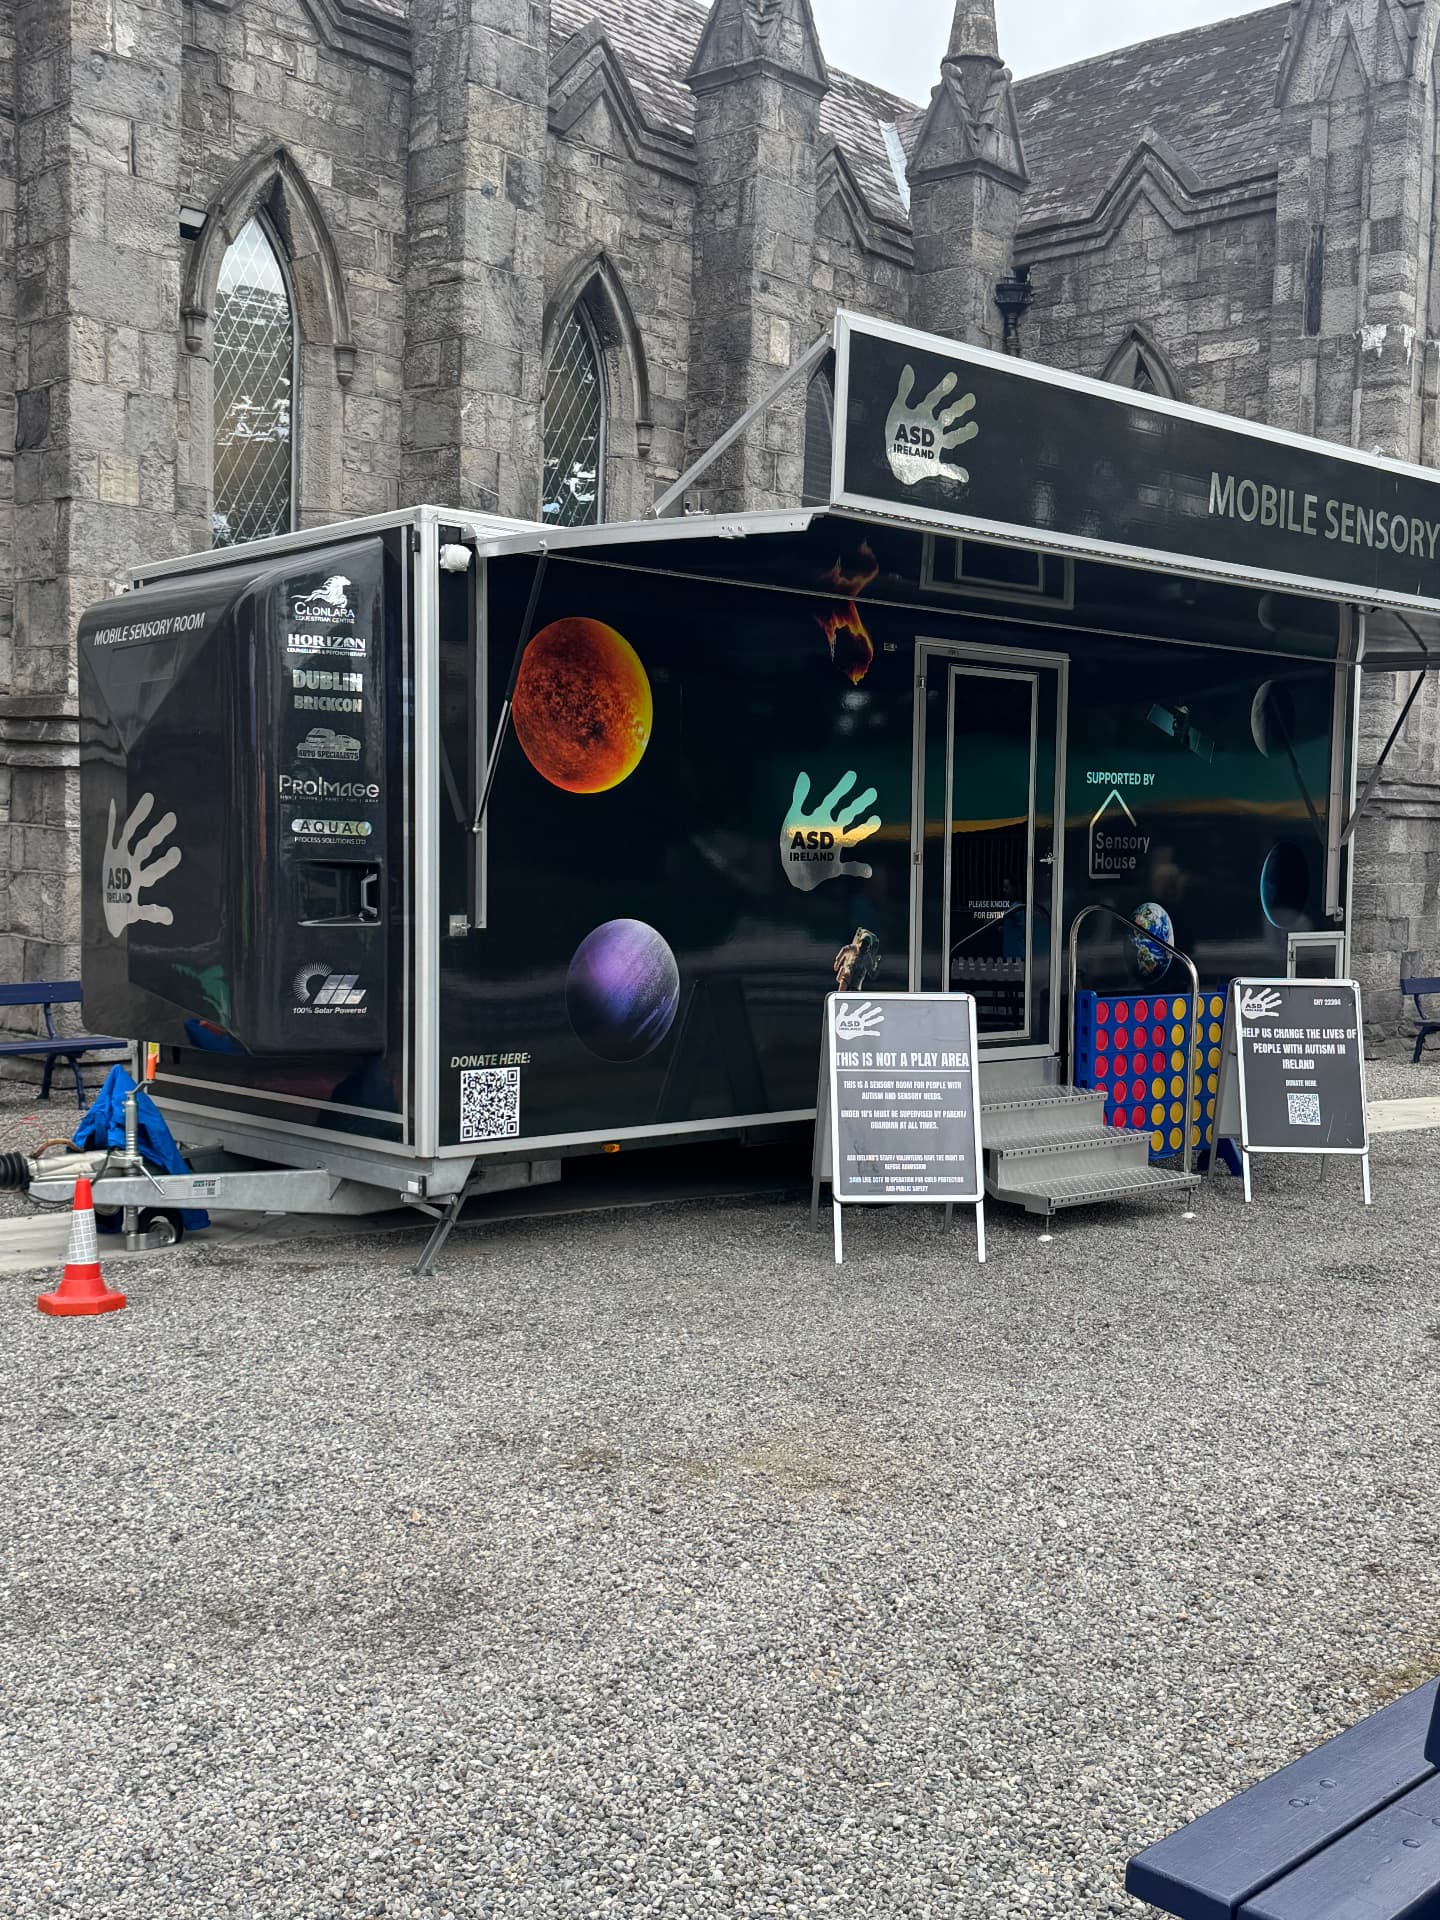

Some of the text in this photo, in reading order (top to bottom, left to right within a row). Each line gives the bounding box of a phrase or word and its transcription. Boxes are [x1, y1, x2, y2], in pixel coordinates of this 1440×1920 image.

[894, 424, 935, 447] ASD
[893, 444, 935, 461] IRELAND
[1208, 471, 1440, 560] MOBILE SENSORY
[295, 602, 355, 618] CLONLARA
[94, 611, 206, 646] MOBILE SENSORY ROOM
[288, 634, 366, 649] HORIZON
[293, 669, 363, 692] DUBLIN
[298, 749, 359, 760] AUTO SPECIALISTS
[1086, 771, 1155, 786] SUPPORTED BY
[294, 836, 321, 844] PROCESS
[321, 837, 355, 845] SOLUTIONS
[791, 831, 834, 850] ASD
[1095, 832, 1150, 854] Sensory
[789, 851, 834, 862] IRELAND
[1095, 852, 1137, 870] House
[107, 867, 132, 890] ASD
[106, 891, 132, 904] IRELAND
[968, 900, 1010, 908] PLEASE KNOCK
[334, 1006, 367, 1014] Powered
[1262, 1028, 1272, 1038] US
[1273, 1028, 1304, 1039] CHANGE
[1306, 1029, 1321, 1039] THE
[1322, 1029, 1344, 1039] LIVES
[1346, 1029, 1357, 1040] OF
[1253, 1043, 1346, 1055] PEOPLE WITH AUTISM IN
[450, 1052, 531, 1068] DONATE HERE:
[836, 1051, 970, 1067] THIS IS NOT A PLAY AREA
[1282, 1059, 1315, 1070] IRELAND
[843, 1080, 961, 1089] THIS IS A SENSORY ROOM FOR PEOPLE WITH
[862, 1092, 883, 1100] AUTISM
[885, 1092, 896, 1100] AND
[898, 1092, 922, 1100] SENSORY
[841, 1110, 859, 1118] UNDER
[874, 1110, 890, 1118] MUST
[900, 1110, 932, 1118] SUPERVISED
[871, 1121, 898, 1129] GUARDIAN
[900, 1121, 907, 1129] AT
[908, 1121, 918, 1129] ALL
